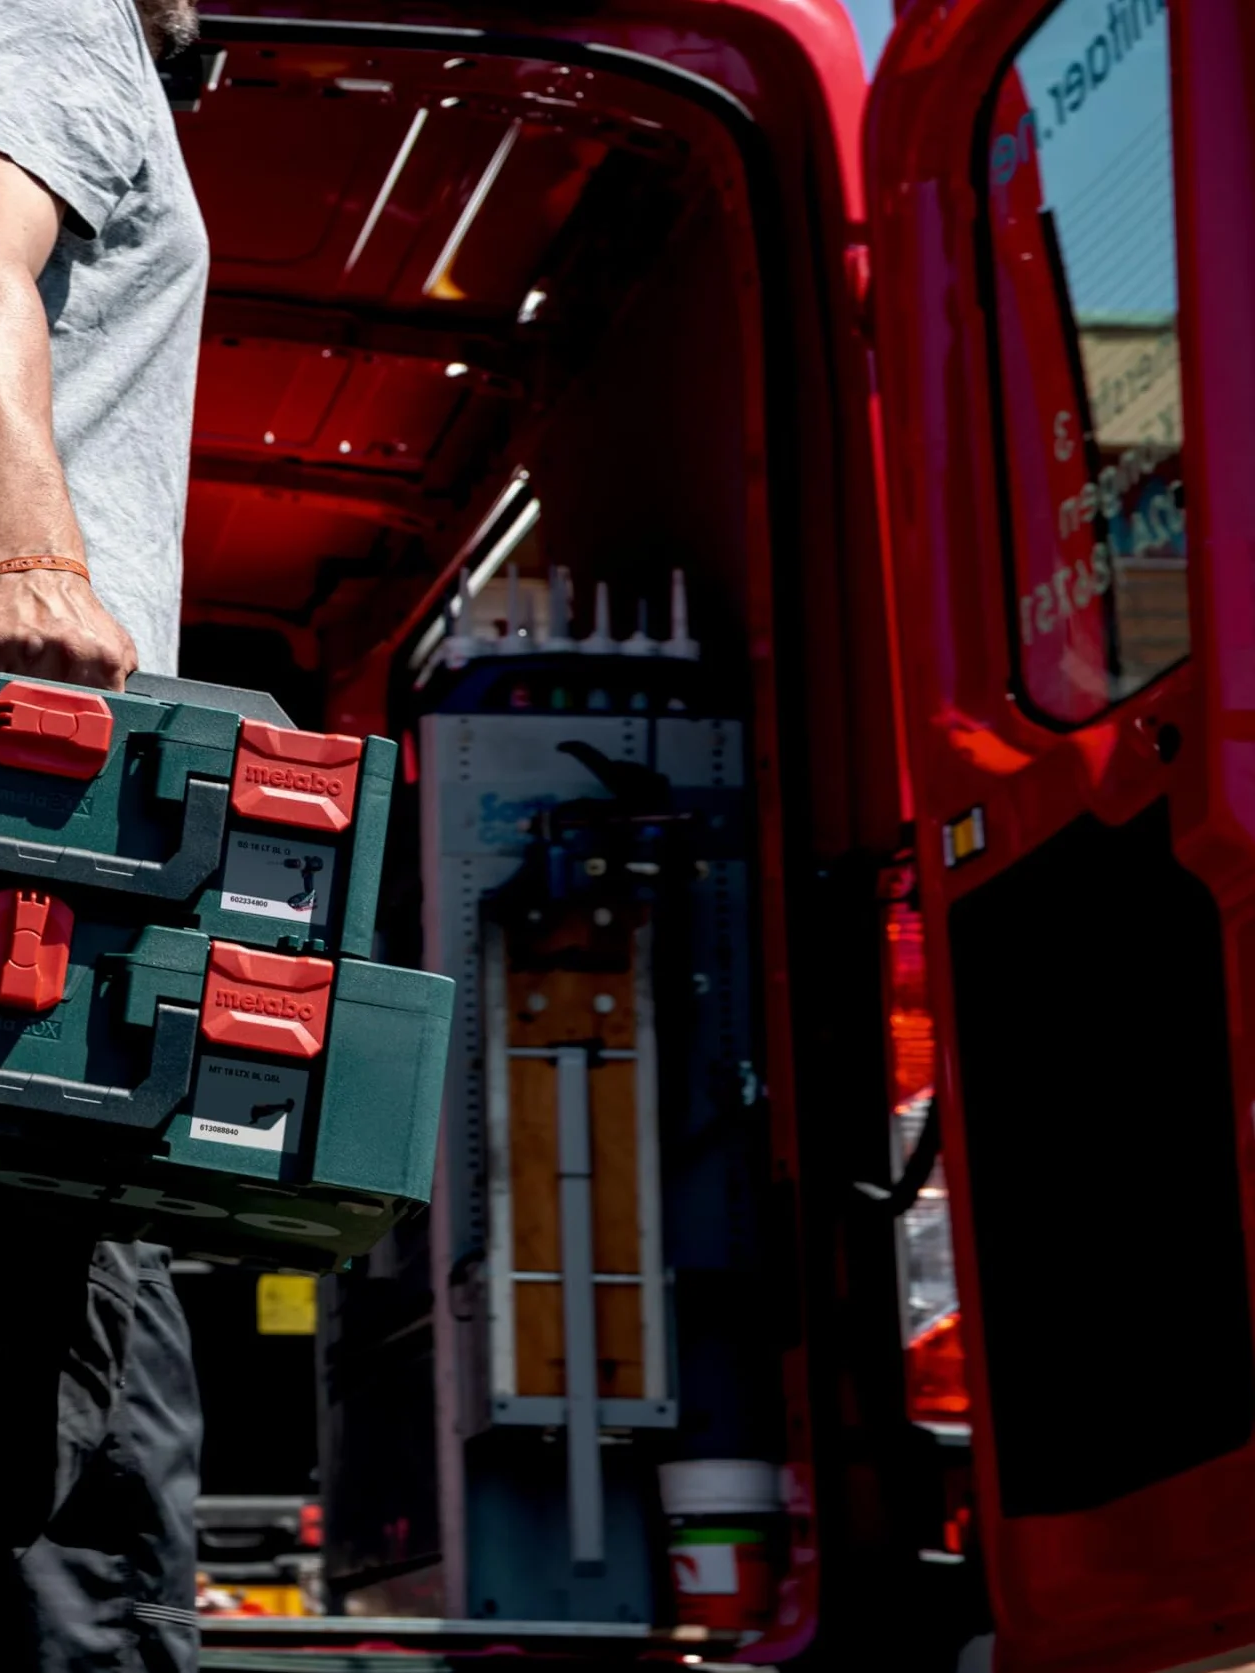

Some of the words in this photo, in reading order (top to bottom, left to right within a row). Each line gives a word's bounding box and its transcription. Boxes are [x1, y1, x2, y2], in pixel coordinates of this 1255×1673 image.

[245, 764, 343, 797] metabo
[230, 896, 268, 908] 602334800
[215, 988, 314, 1021] metabo
[199, 1124, 239, 1136] 613088840
